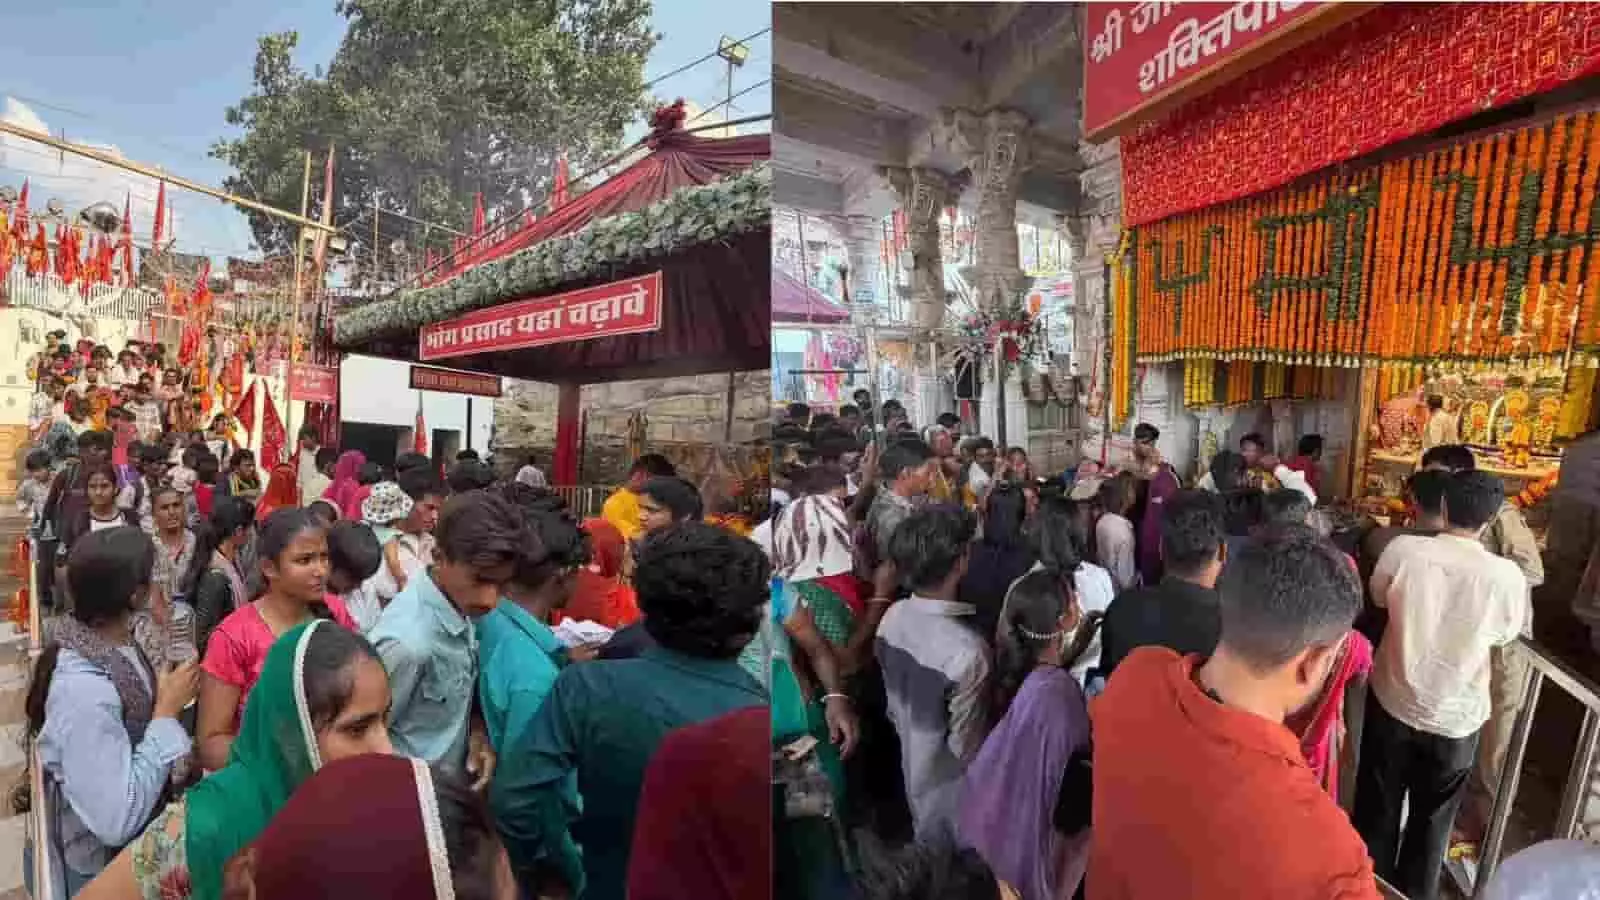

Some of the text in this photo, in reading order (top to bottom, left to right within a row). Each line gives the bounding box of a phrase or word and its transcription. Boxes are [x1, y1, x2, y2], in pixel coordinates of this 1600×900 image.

[1090, 8, 1125, 64] श्री
[461, 316, 513, 344] प्रसाद
[515, 299, 567, 333] यहां
